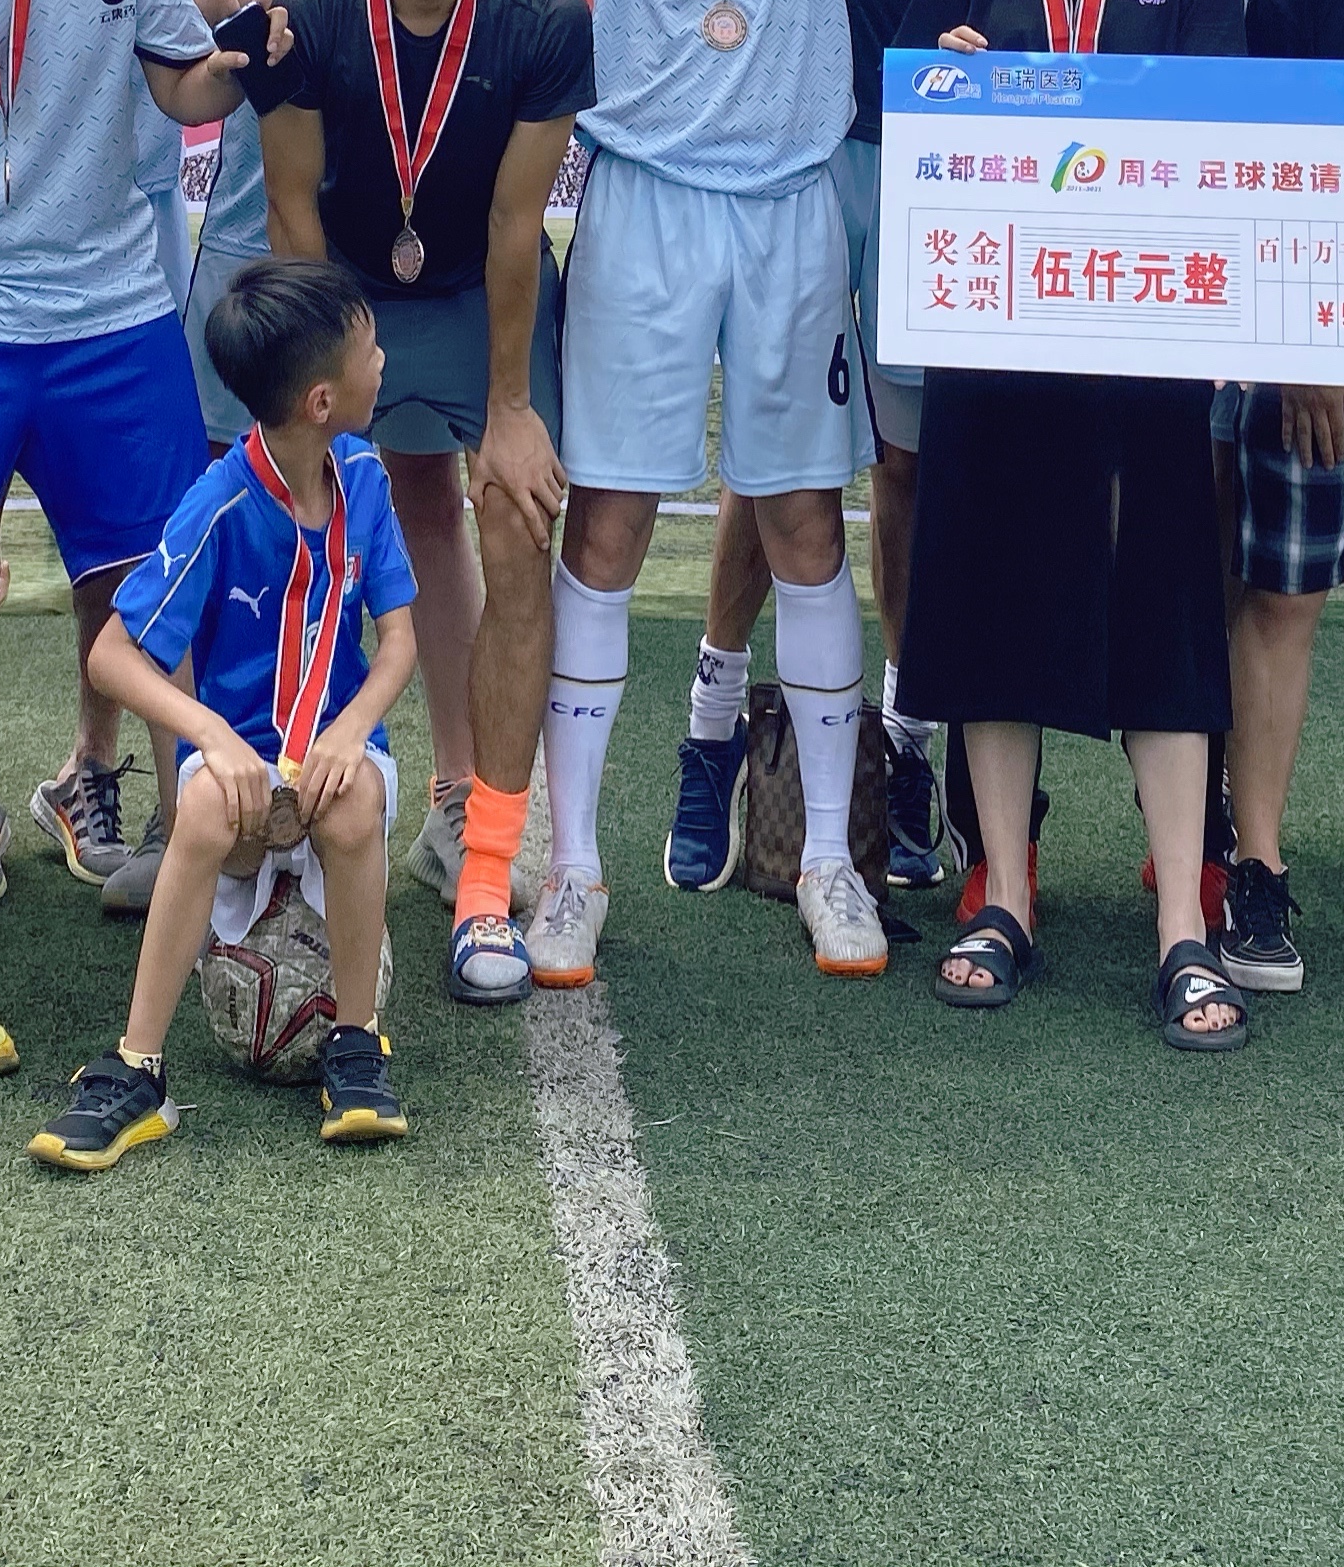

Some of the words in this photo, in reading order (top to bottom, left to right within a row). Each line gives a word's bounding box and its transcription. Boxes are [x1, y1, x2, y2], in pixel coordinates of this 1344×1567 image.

[990, 66, 1084, 92] 恒瑞医药
[923, 229, 1002, 266] 奖金
[922, 274, 1002, 313] 支票
[1030, 246, 1229, 307] 伍仟元整
[828, 333, 850, 406] 6
[551, 701, 606, 718] CFC
[1190, 977, 1217, 991] NIKE
